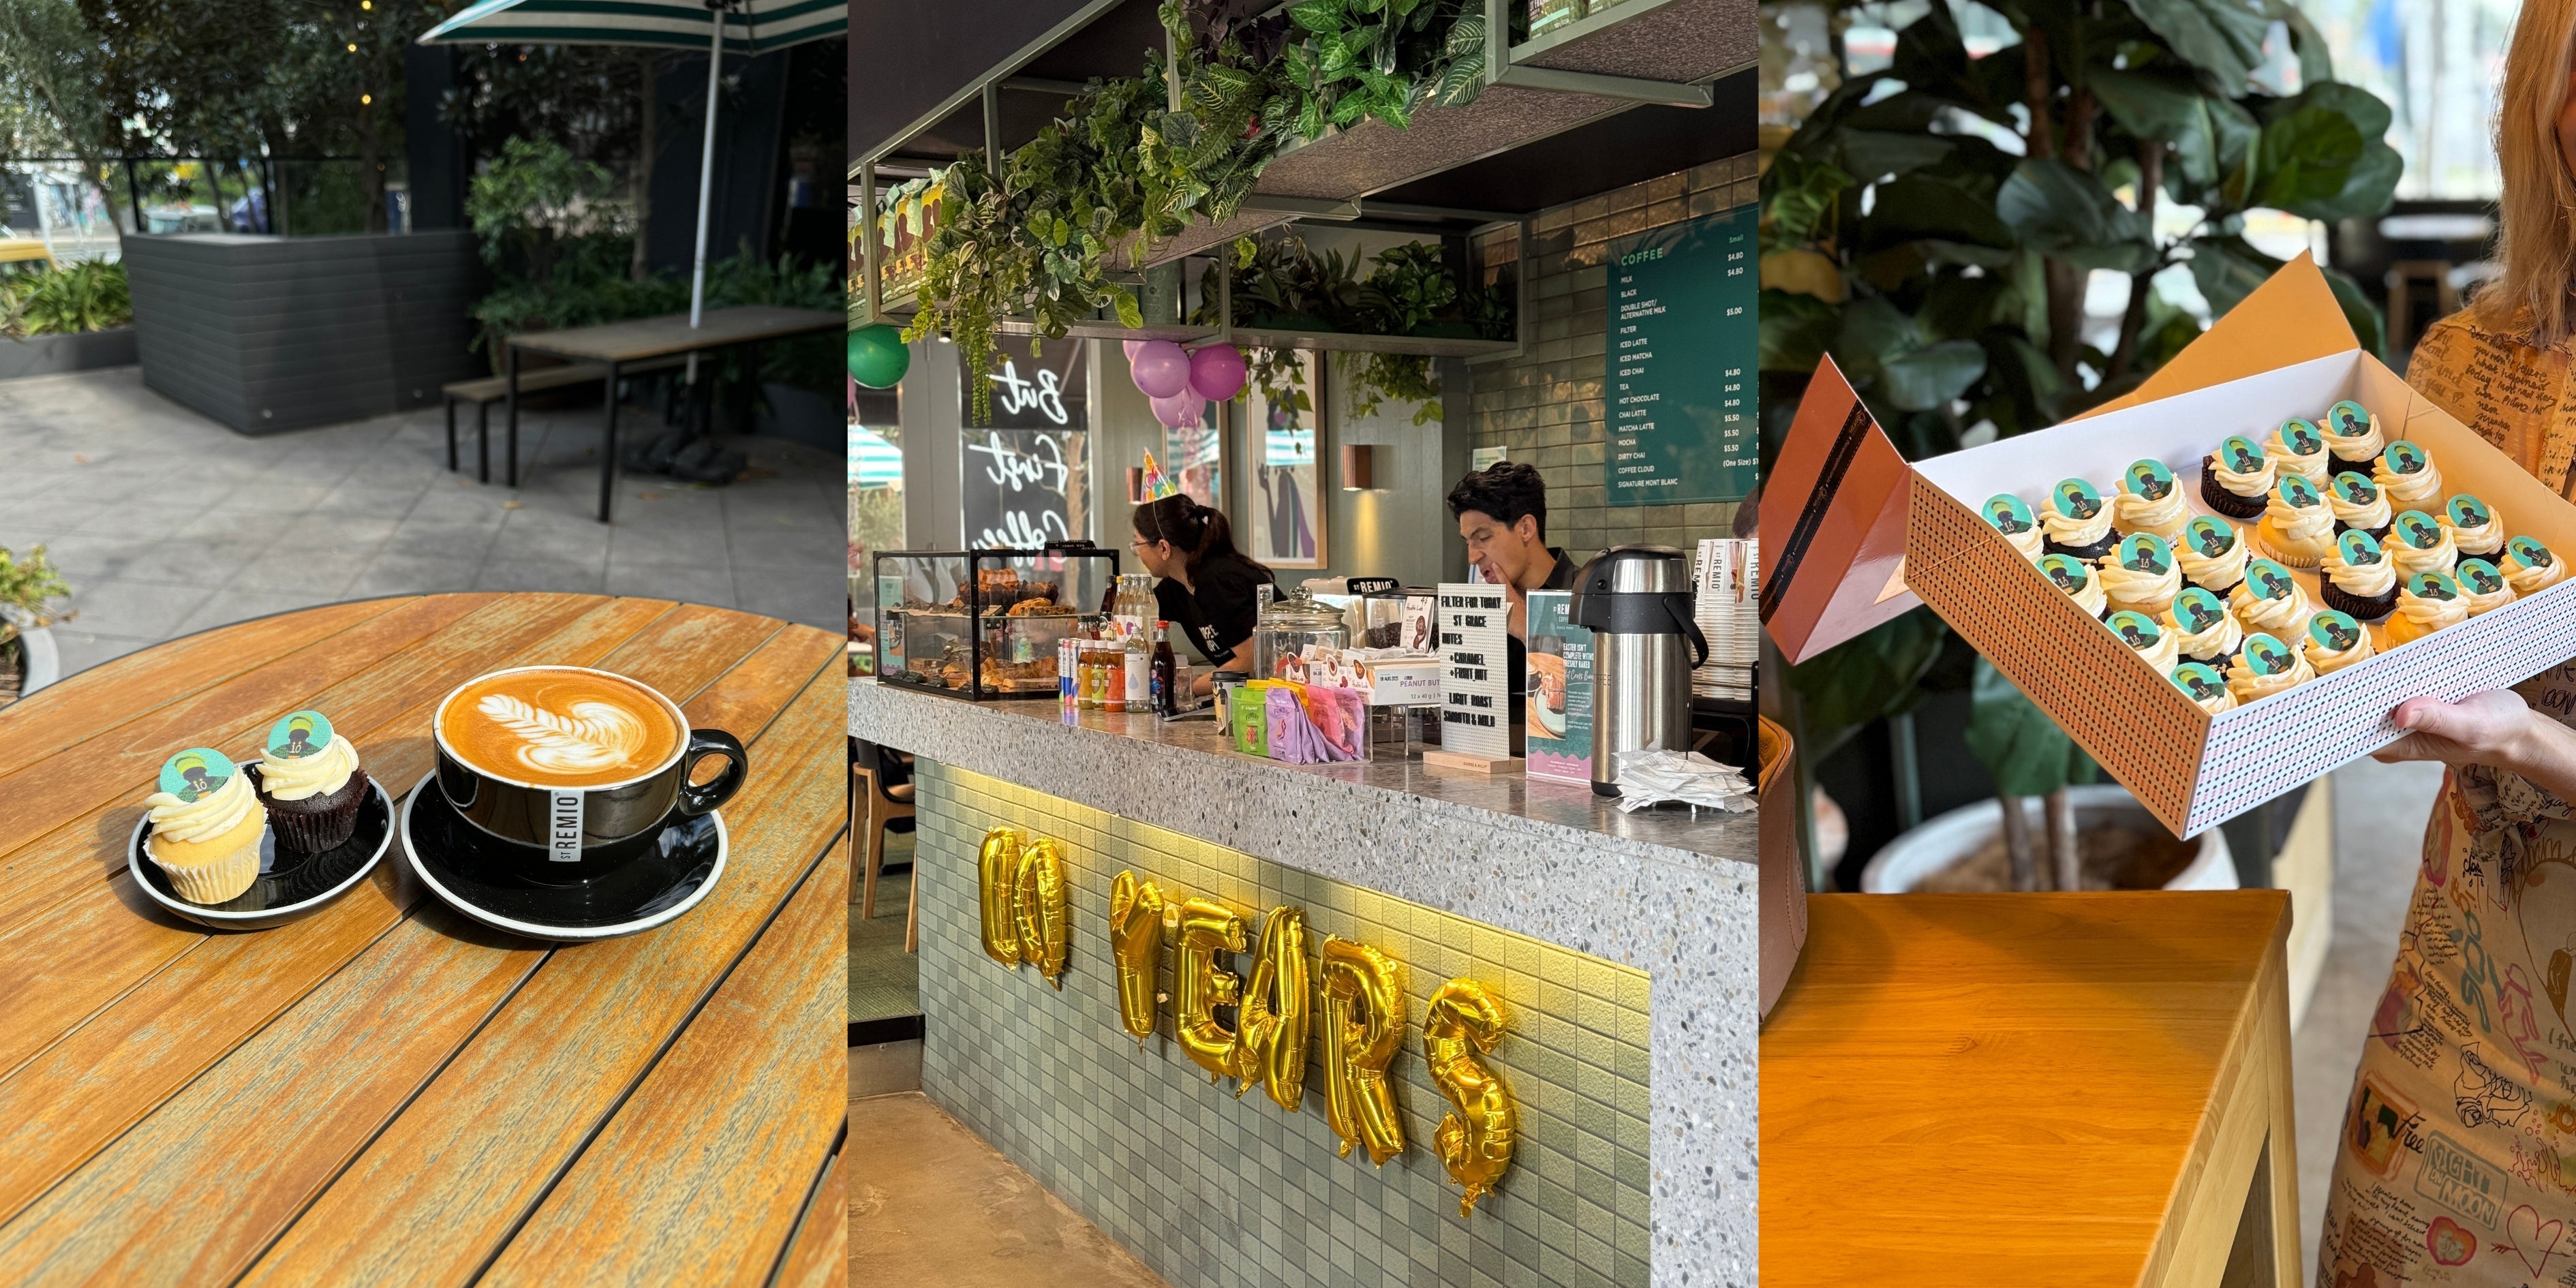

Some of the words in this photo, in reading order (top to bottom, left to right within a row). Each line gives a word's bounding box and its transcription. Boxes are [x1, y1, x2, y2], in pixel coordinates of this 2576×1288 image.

[1729, 234, 1744, 243] Small
[1621, 247, 1663, 266] COFFEE
[1728, 251, 1743, 262] $4.80
[1728, 266, 1743, 277] $4.80
[1621, 275, 1633, 283] MILK
[1621, 289, 1637, 298] BLACK
[1621, 302, 1640, 312] DOUBLE
[1641, 298, 1657, 308] SHOT/
[1620, 308, 1653, 320] ALTERNATIVE
[1653, 305, 1666, 313] MILK
[1726, 306, 1743, 317] $5.00
[1620, 325, 1637, 334] FILTER
[1632, 338, 1648, 346] LATTE
[1619, 354, 1631, 363] ICED
[1632, 352, 1653, 361] MATCHA
[1725, 368, 1741, 377] $4.80
[1724, 384, 1741, 392] $4.80
[1619, 397, 1629, 405] HOT
[1629, 393, 1660, 403] CHOCOLATE
[1724, 399, 1740, 407] $4.80
[1631, 409, 1646, 417] LATTE
[1724, 414, 1740, 423] $5.50
[1619, 424, 1638, 432] MATCHA
[1639, 423, 1655, 431] LATTE
[1724, 429, 1739, 438] $5.50
[1723, 444, 1739, 453] $5.50
[1618, 453, 1632, 461] DIRTY
[1723, 459, 1736, 467] (One
[1737, 458, 1751, 466] Size)
[1618, 466, 1637, 474] COFFEE
[1618, 480, 1644, 488] SIGNATURE
[1660, 478, 1678, 486] BLANC
[1693, 559, 1702, 585] REM
[1441, 596, 1464, 608] FILTER
[1465, 596, 1478, 608] FOR
[1479, 597, 1501, 609] TODAY
[1557, 604, 1570, 615] REM
[1453, 615, 1462, 626] ST
[1465, 615, 1487, 627] GRACE
[1442, 632, 1462, 645] NOTES
[1563, 643, 1576, 651] EASTER
[1577, 643, 1587, 651] ISN'T
[1563, 660, 1578, 668] FRESHLY
[1449, 692, 1468, 705] LIGHT
[1471, 694, 1492, 707] ROAST
[1443, 710, 1471, 724] SMOOTH
[1471, 713, 1477, 726] &
[1477, 714, 1495, 727] MILD
[290, 744, 302, 754] 10
[196, 781, 207, 792] 10
[1109, 869, 1515, 1203] YEARS
